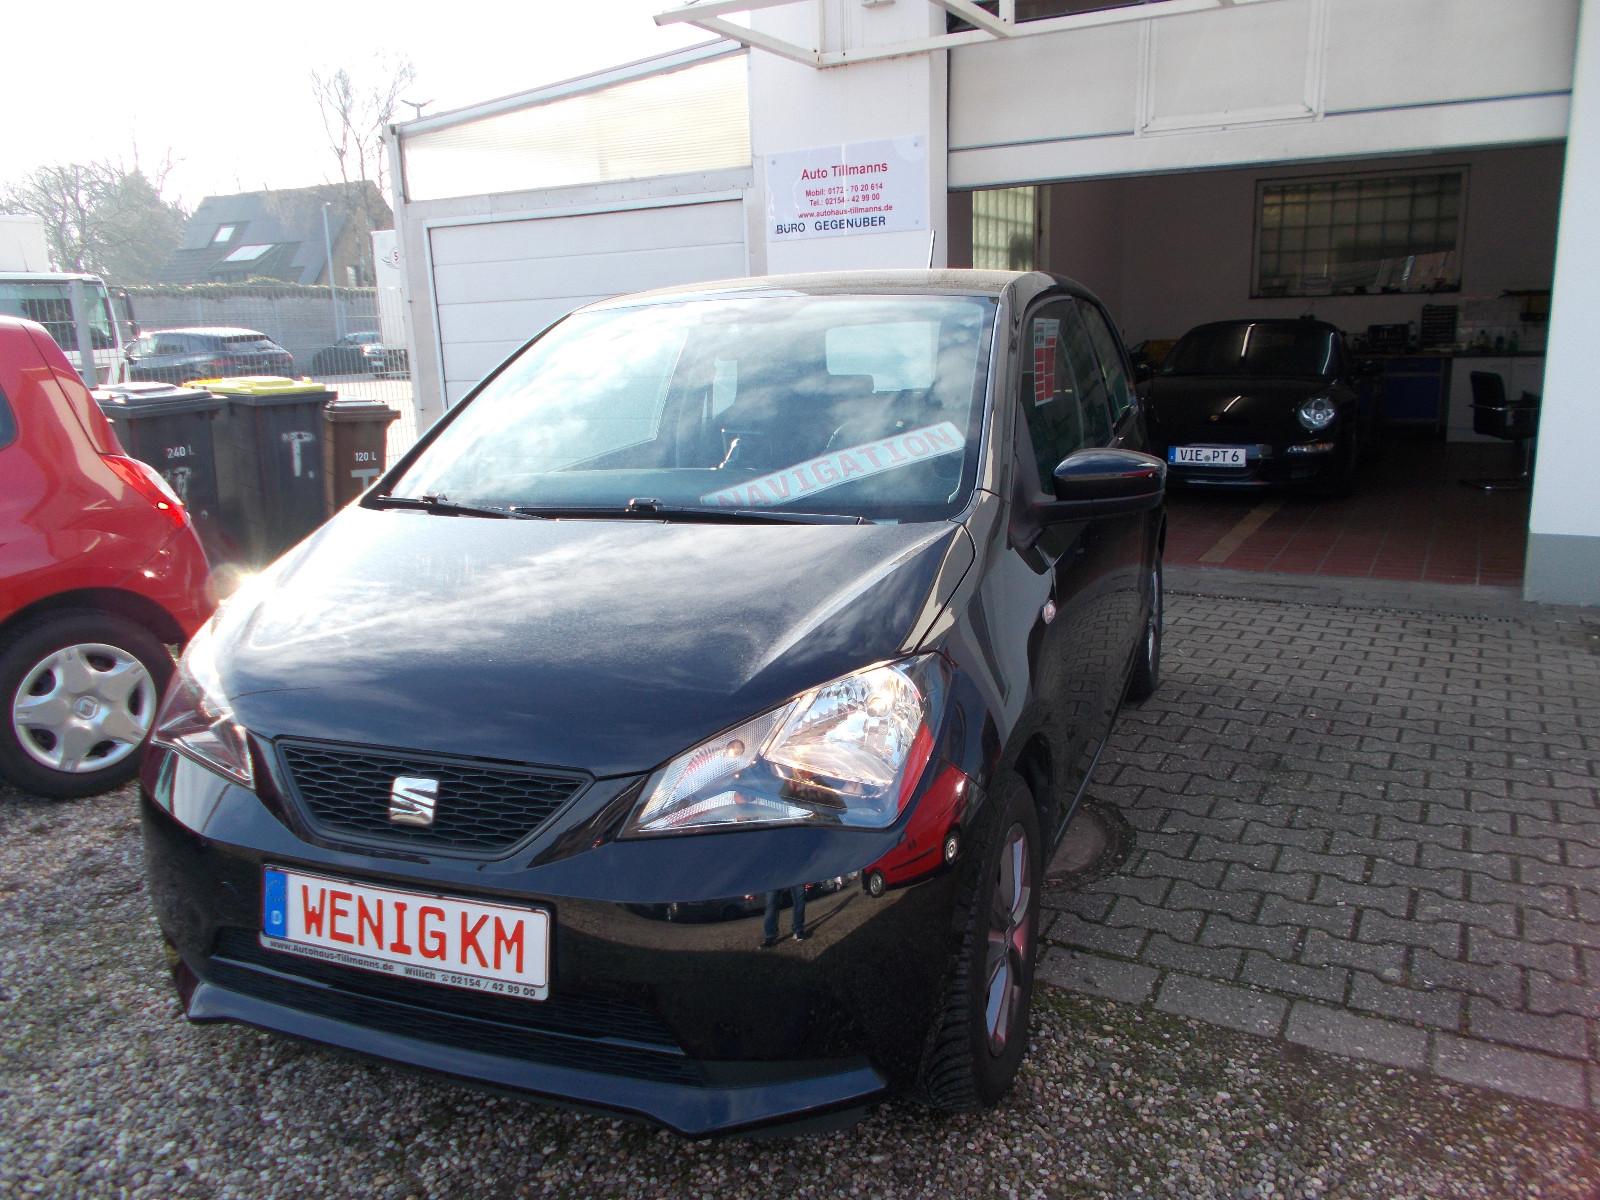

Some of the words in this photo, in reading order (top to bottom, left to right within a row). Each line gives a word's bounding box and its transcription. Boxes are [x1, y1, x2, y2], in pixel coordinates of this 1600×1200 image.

[801, 168, 828, 180] Auto
[831, 162, 888, 177] Tillmanns
[805, 188, 826, 197] Mobil:
[828, 186, 844, 195] 0172
[850, 184, 859, 193] 70
[860, 183, 869, 192] 20
[870, 182, 883, 191] 614
[825, 196, 845, 205] 02154
[851, 194, 860, 203] 42
[862, 193, 870, 202] 99
[871, 192, 880, 201] 00
[798, 204, 893, 219] www.autohaus-tillmanns.de
[776, 222, 806, 235] BÜRO
[167, 446, 186, 459] 240
[355, 451, 369, 462] 120
[371, 451, 377, 461] L
[1180, 449, 1203, 462] VIE
[1212, 450, 1229, 462] PT
[1231, 450, 1240, 463] 6
[715, 426, 957, 507] NAVIGATION
[301, 884, 447, 961] WENIG
[459, 911, 524, 974] KM
[270, 940, 395, 972] www.Autohaus-Tillmanns.de
[404, 967, 436, 980] Willich
[451, 975, 481, 987] 02154
[491, 981, 504, 992] 42
[507, 984, 520, 995] 99
[523, 988, 536, 997] 00
